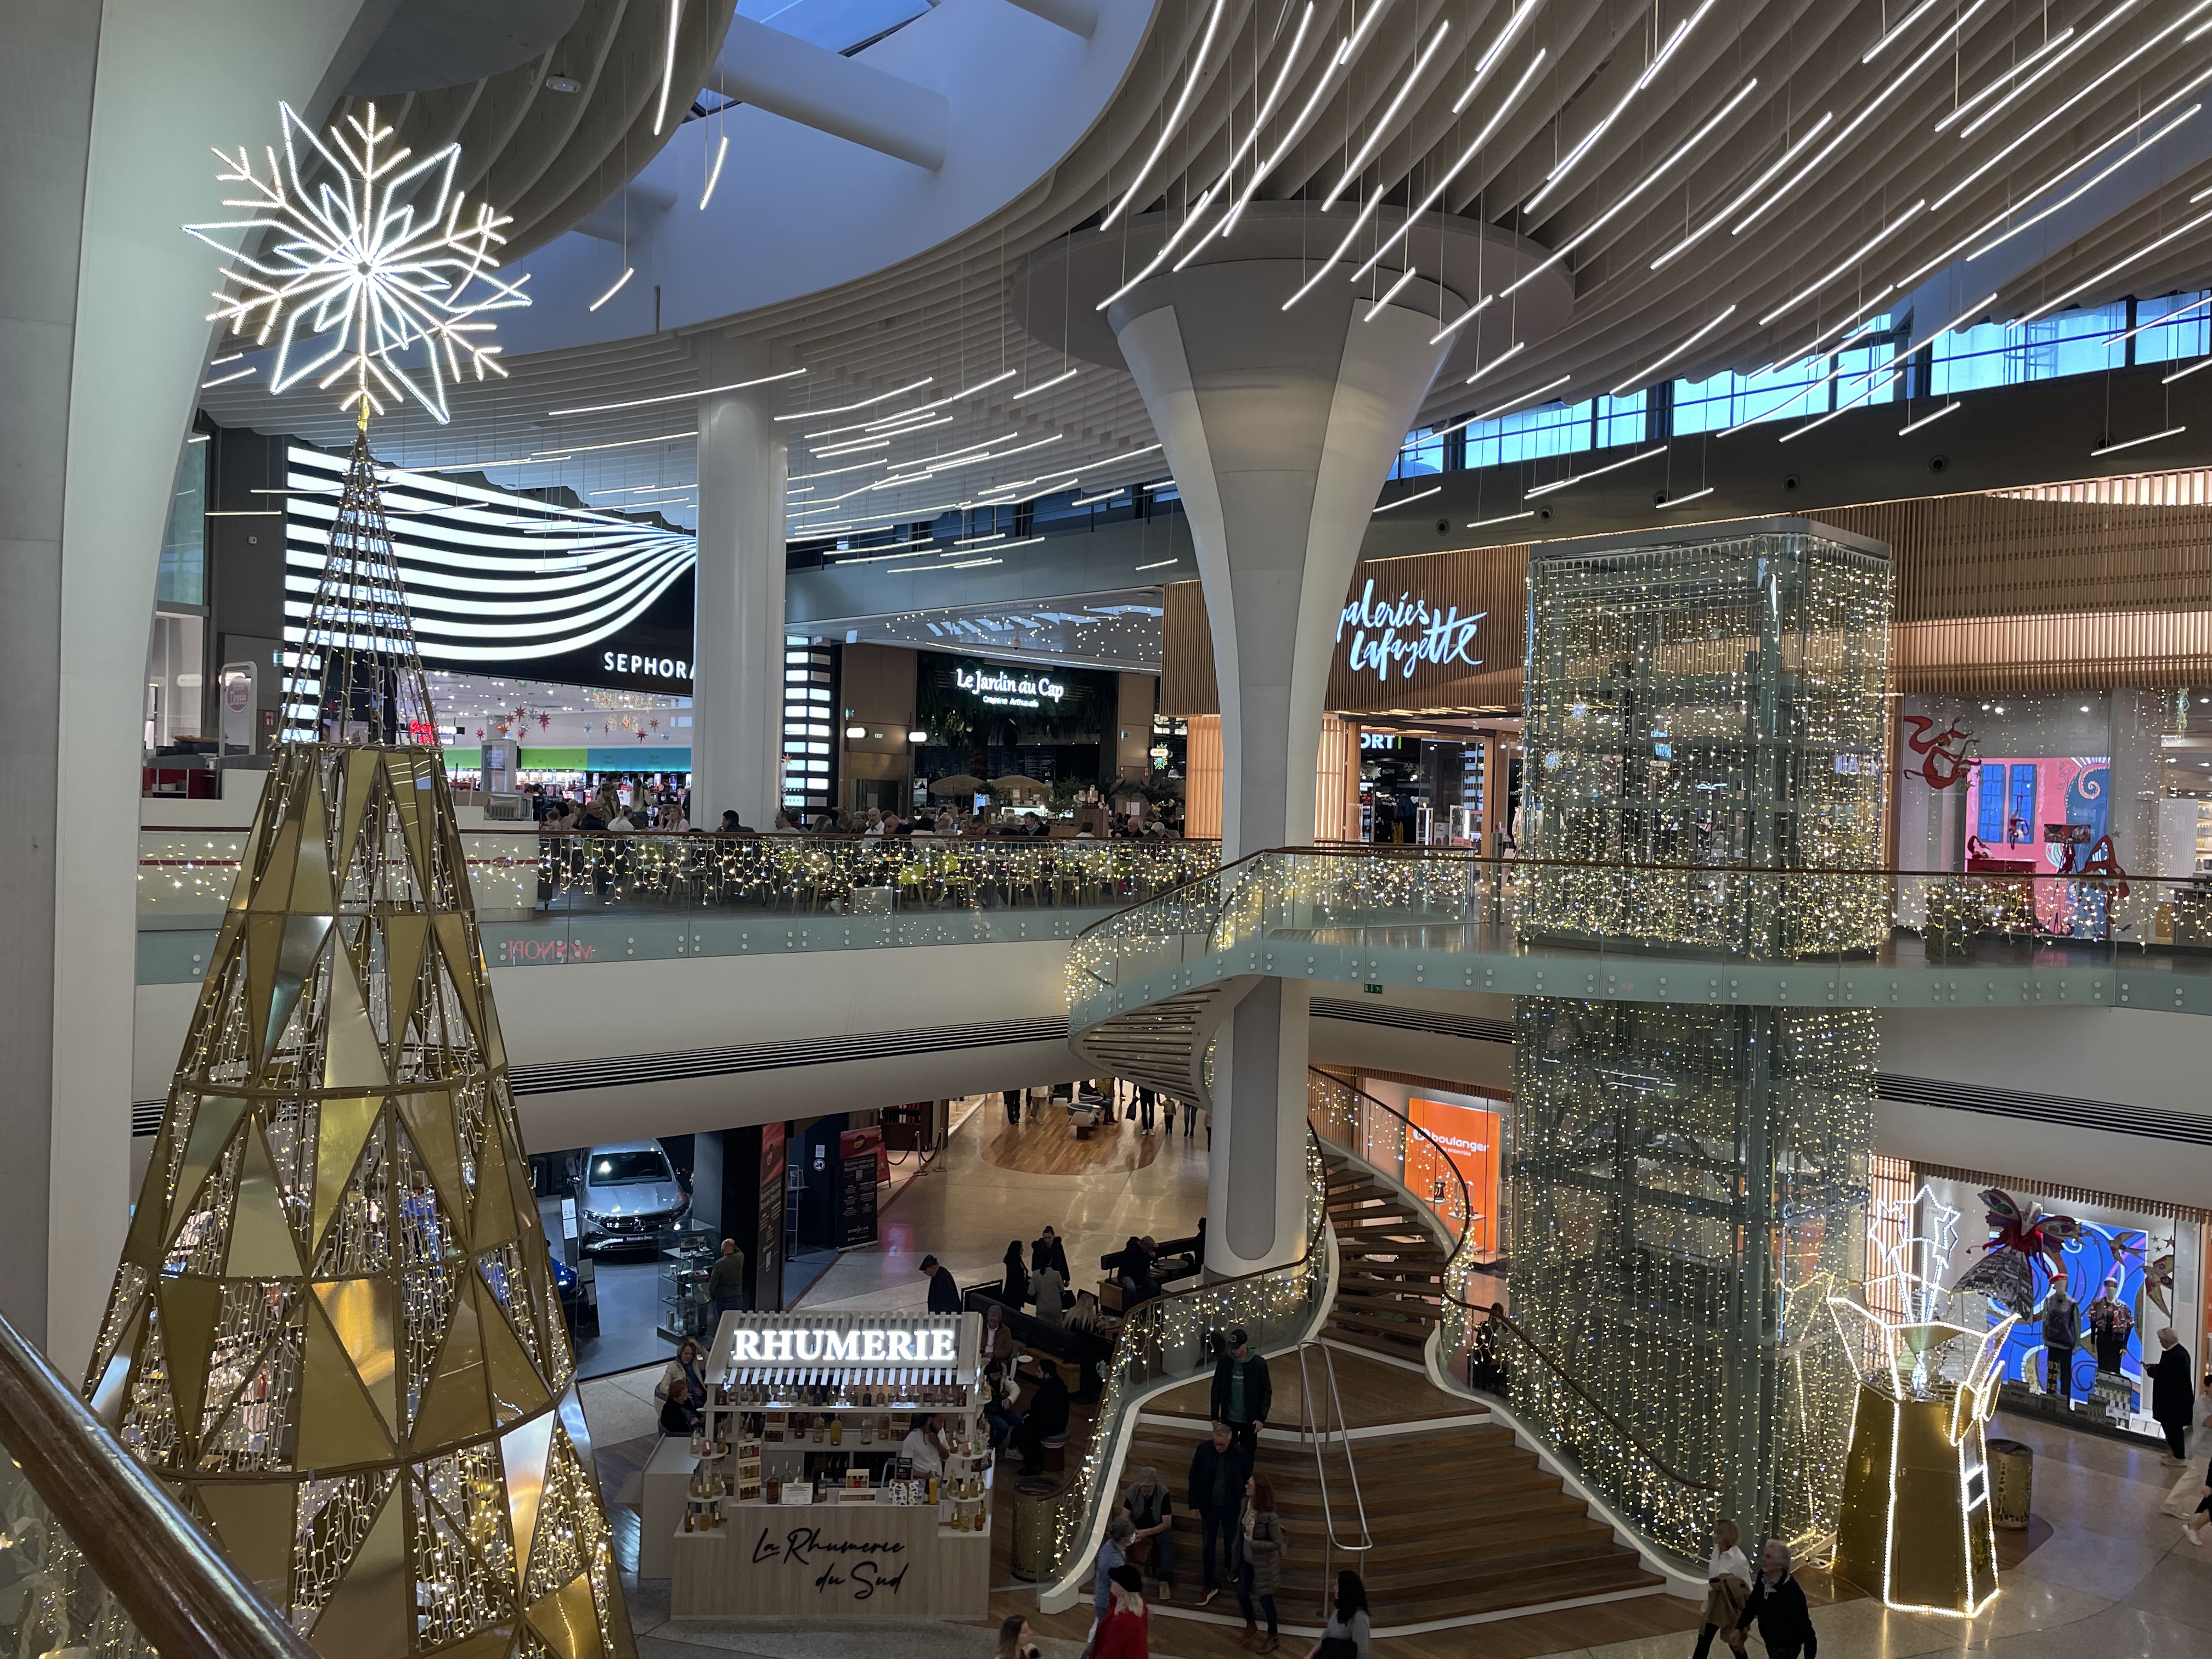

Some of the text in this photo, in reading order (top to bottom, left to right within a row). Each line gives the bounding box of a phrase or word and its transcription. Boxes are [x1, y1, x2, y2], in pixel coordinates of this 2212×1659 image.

[1350, 606, 1488, 681] Lafayette
[956, 668, 974, 689] Le
[972, 670, 1017, 695] Jardin
[1038, 678, 1064, 703] Cap
[1360, 732, 1396, 749] ORT
[1431, 1132, 1488, 1152] boulanger
[733, 1329, 956, 1361] RHUMERIE
[753, 1527, 905, 1565] La Rhumerie
[815, 1561, 909, 1599] du Sud
